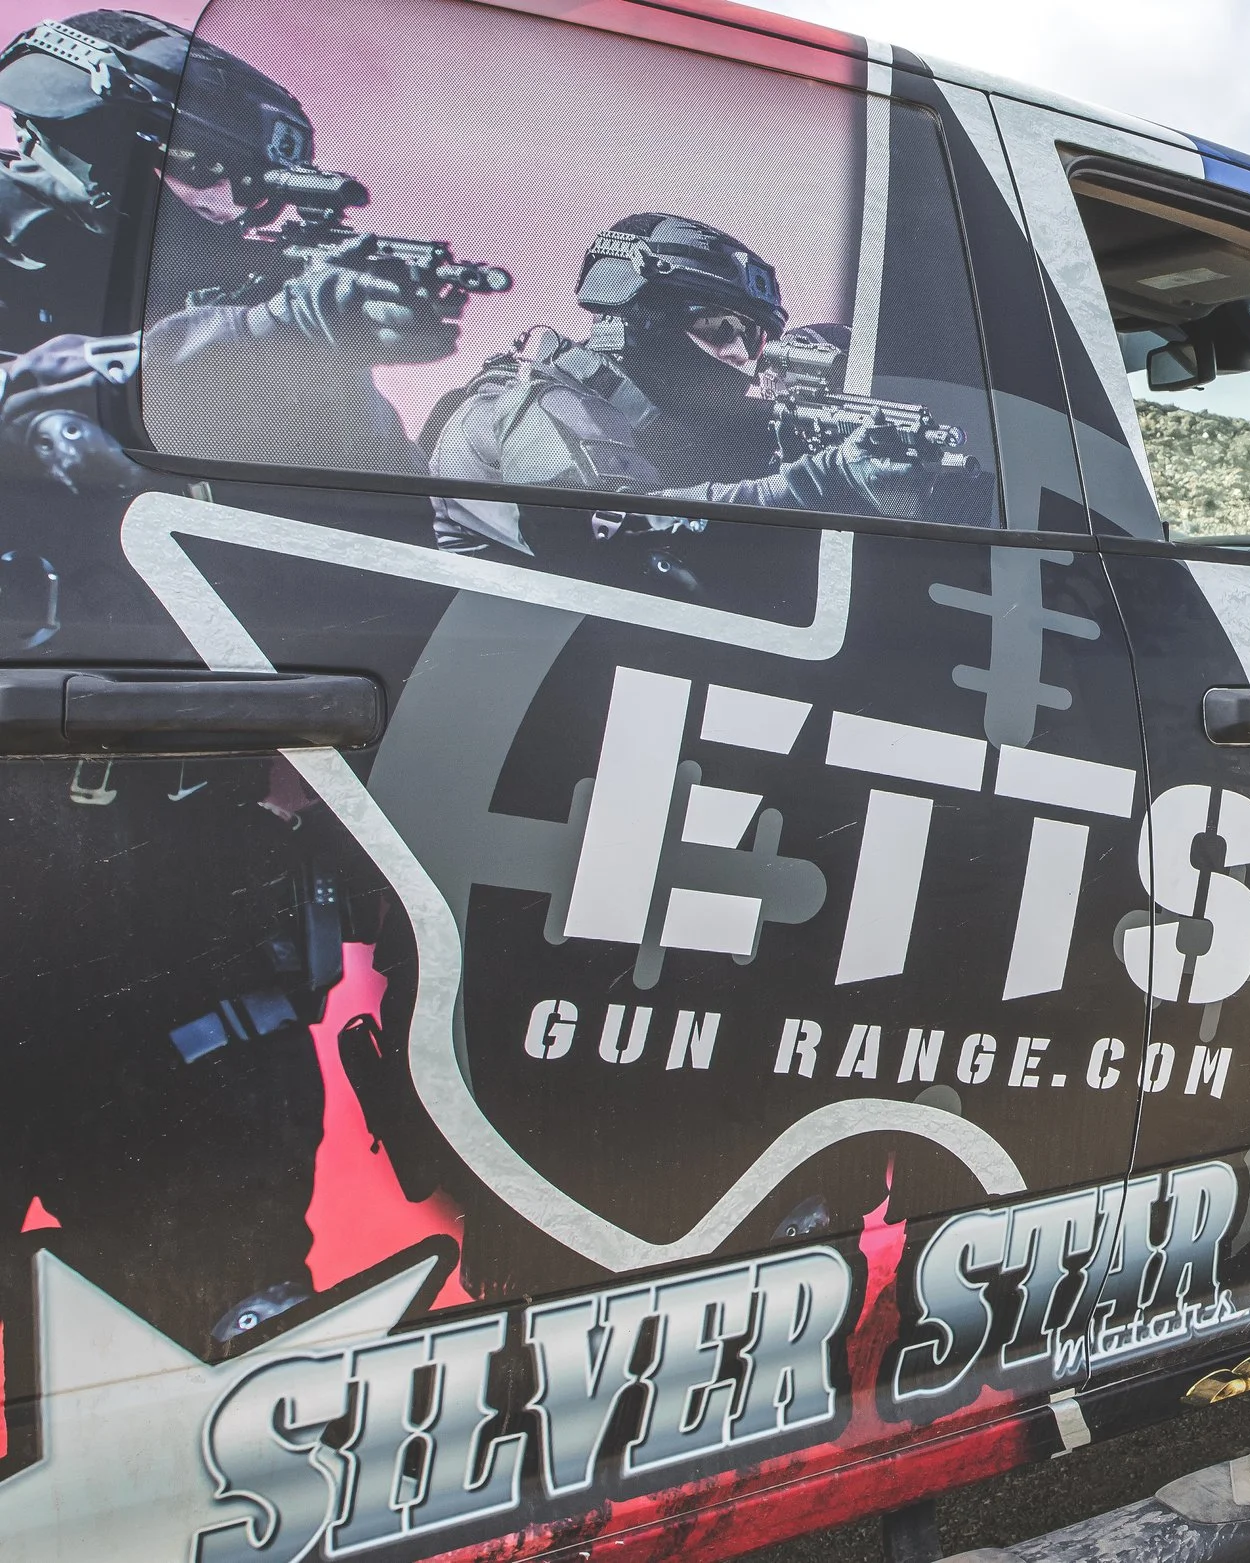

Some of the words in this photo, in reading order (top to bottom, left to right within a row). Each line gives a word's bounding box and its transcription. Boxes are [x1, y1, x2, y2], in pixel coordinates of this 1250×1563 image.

[524, 1000, 721, 1070] GUN
[774, 1018, 1233, 1099] RANGE.COM
[191, 1244, 853, 1563] SILVER
[894, 1160, 1240, 1402] STAR
